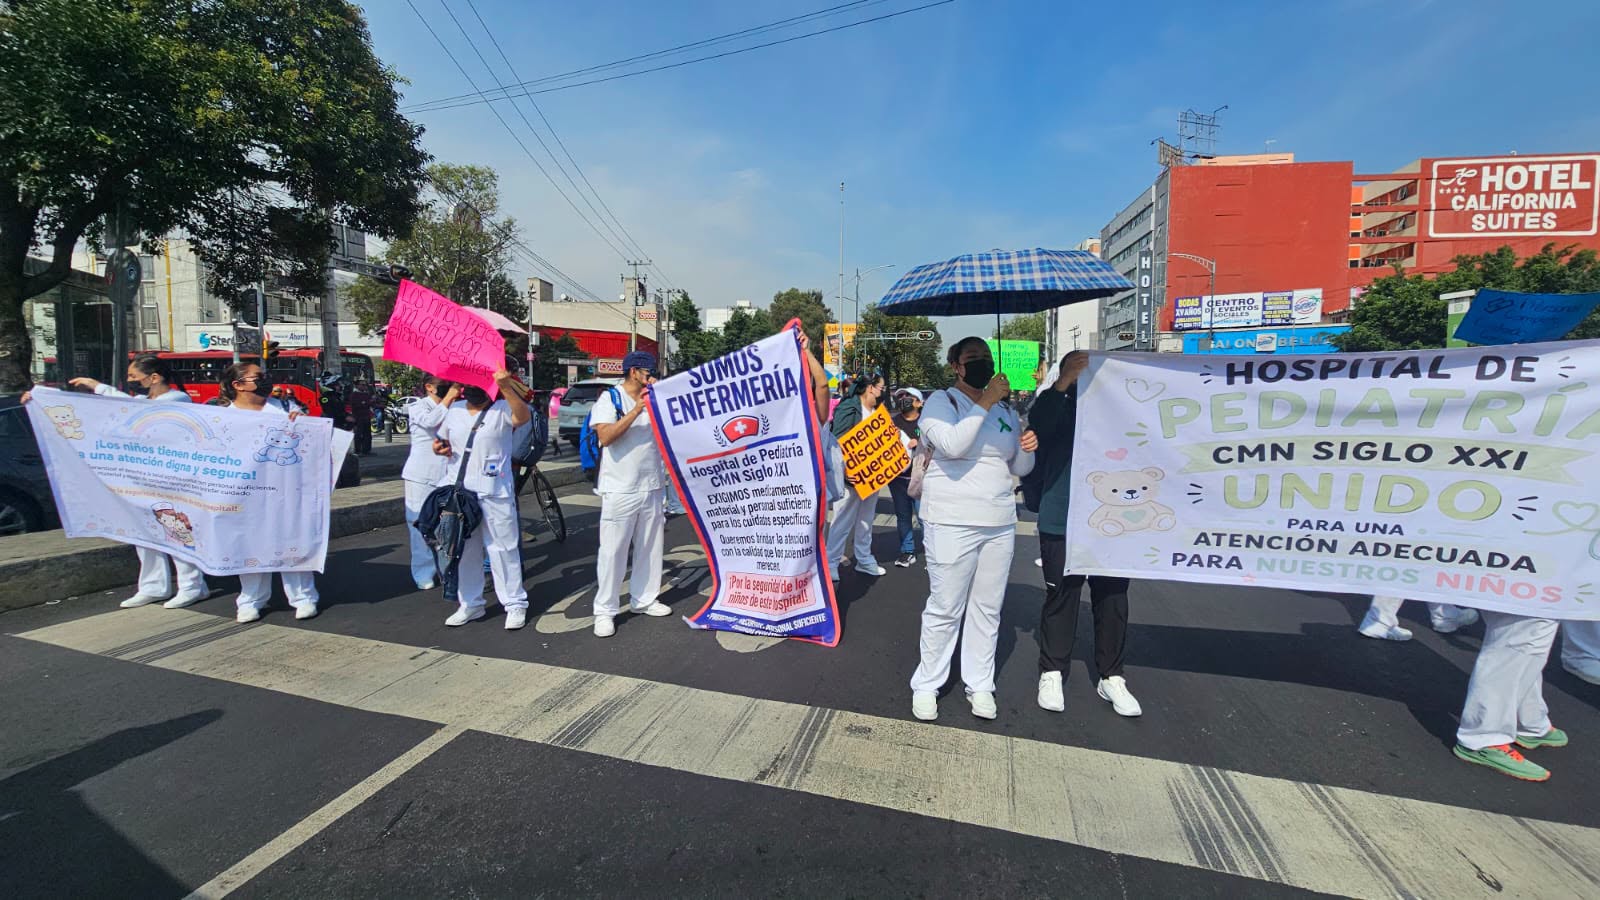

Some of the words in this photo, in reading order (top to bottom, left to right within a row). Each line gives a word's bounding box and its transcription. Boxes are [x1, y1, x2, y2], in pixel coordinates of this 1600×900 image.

[1481, 163, 1591, 191] HOTEL
[1451, 192, 1577, 211] CALIFORNIA
[1471, 212, 1558, 231] SUITES
[1141, 257, 1150, 343] HOTEL
[1207, 297, 1255, 307] CENTRO
[1218, 305, 1260, 313] EVENTOS
[600, 362, 623, 371] OXXO
[688, 344, 764, 389] SOMOS
[1226, 356, 1452, 386] HOSPITAL
[1475, 355, 1540, 382] DE
[665, 363, 799, 427] ENFERMERÍA
[841, 413, 886, 456] menos
[78, 451, 85, 459] a
[90, 451, 114, 461] una
[118, 454, 164, 468] atención
[166, 459, 191, 473] digna
[193, 466, 200, 475] y
[202, 467, 257, 480] segura!
[95, 440, 121, 450] ¡Los
[123, 441, 154, 454] niños
[157, 445, 190, 460] tienen
[191, 451, 242, 467] derecho
[690, 456, 740, 478] Hospital
[742, 453, 758, 468] de
[758, 442, 804, 461] Pediatría
[852, 440, 904, 486] querem
[1212, 442, 1296, 465] CMN
[1312, 441, 1434, 464] SIGLO
[1448, 445, 1529, 471] XXI
[711, 470, 742, 488] CMN
[742, 465, 773, 482] Siglo
[774, 462, 789, 478] XXI
[706, 504, 740, 518] material
[740, 506, 747, 516] y
[777, 497, 812, 510] suficiente
[707, 488, 750, 505] EXIGIMOS
[1223, 472, 1502, 521] UNIDO
[711, 520, 730, 531] para
[730, 517, 741, 528] los
[1287, 518, 1346, 534] PARA
[1354, 522, 1405, 536] UNA
[719, 534, 756, 545] Queremos
[776, 533, 783, 544] la
[721, 547, 734, 557] con
[734, 546, 741, 556] la
[774, 546, 784, 558] los
[1193, 531, 1338, 554] ATENCIÓN
[1349, 541, 1538, 574] ADECUADA
[730, 575, 743, 588] ¡Por
[744, 576, 751, 590] la
[781, 579, 792, 594] de
[794, 576, 809, 590] los
[1171, 552, 1244, 570] PARA
[1256, 557, 1420, 585] NUESTROS
[1435, 570, 1563, 602] NIÑOS
[728, 591, 748, 605] niños
[749, 593, 759, 607] de
[759, 597, 771, 609] este
